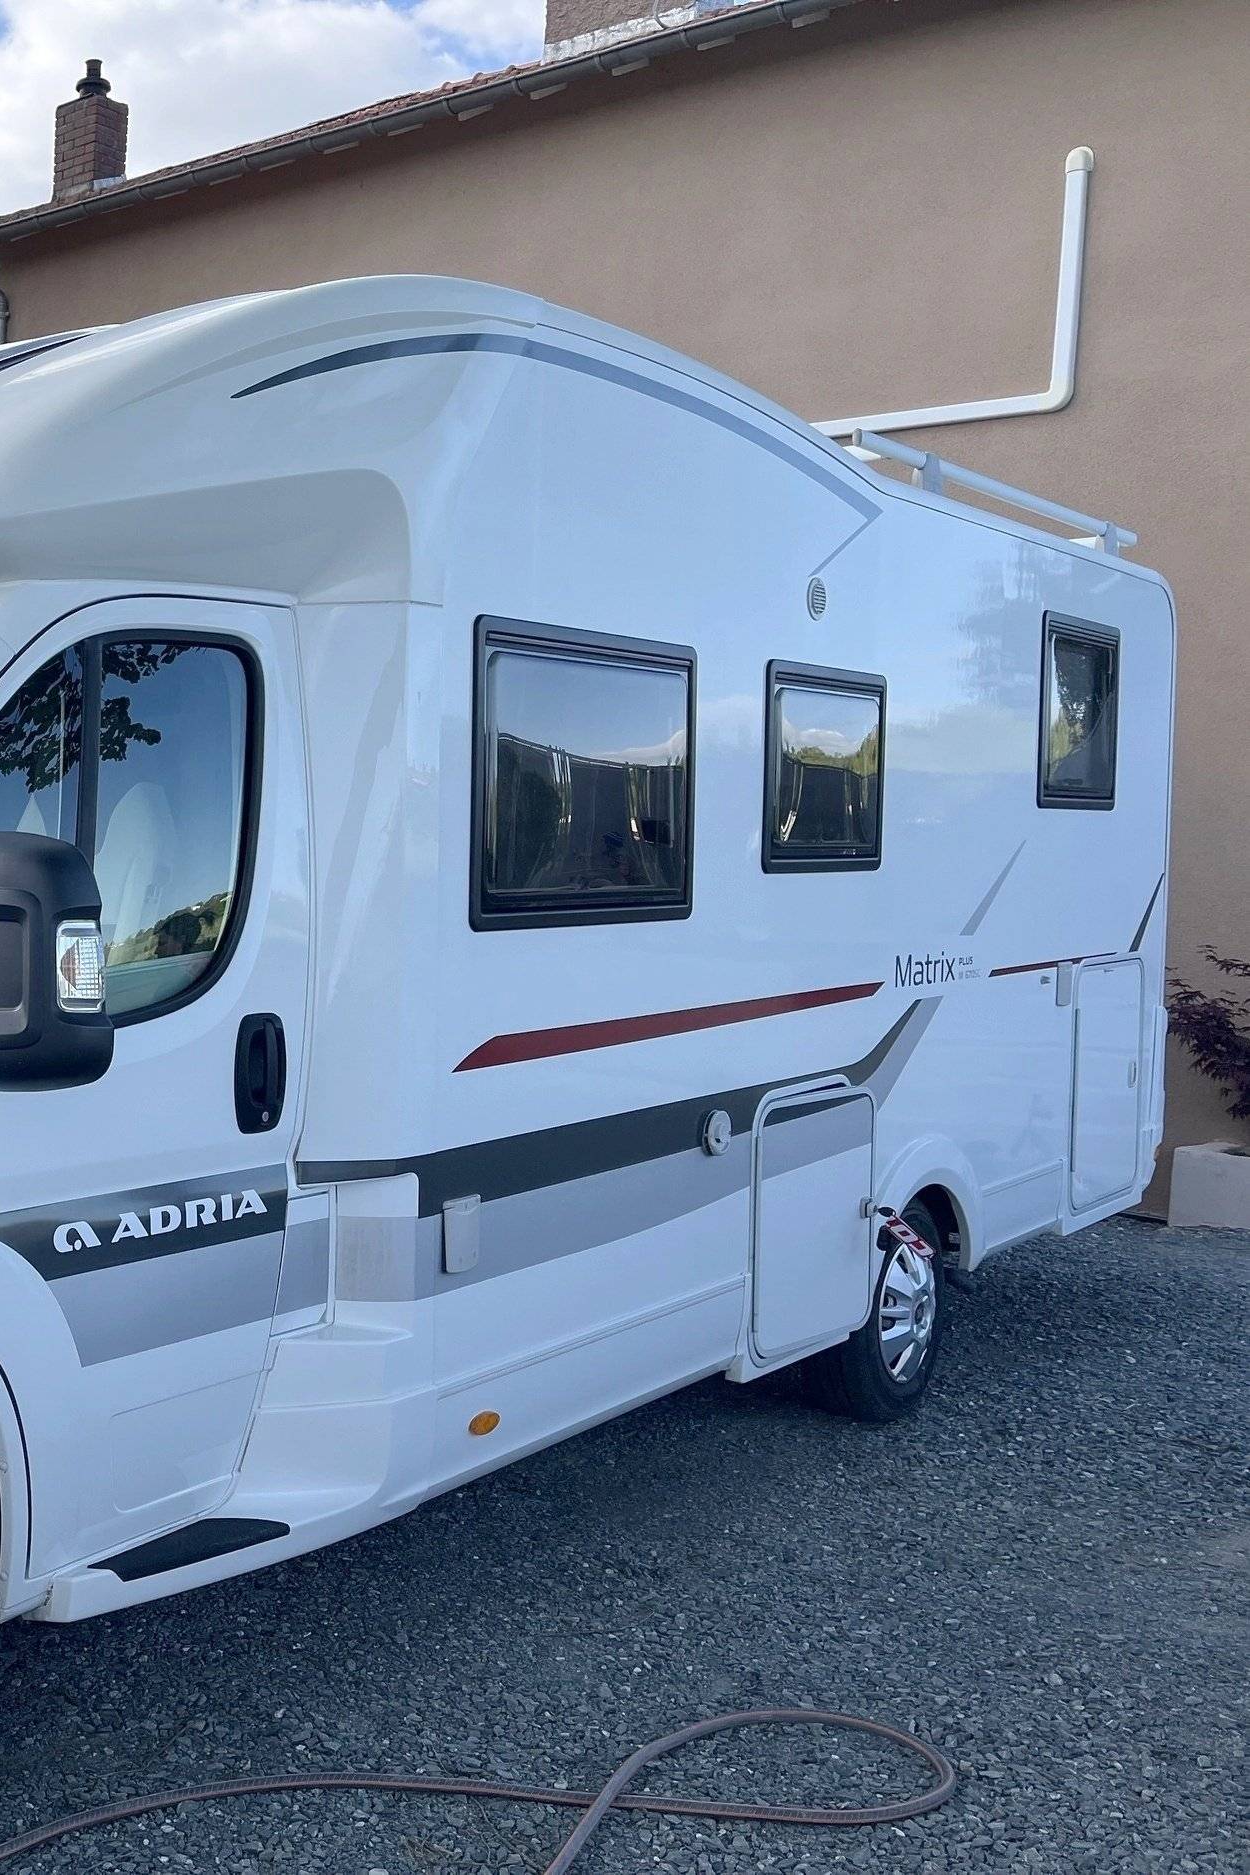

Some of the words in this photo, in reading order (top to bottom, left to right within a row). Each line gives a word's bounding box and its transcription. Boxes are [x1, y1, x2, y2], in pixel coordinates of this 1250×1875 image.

[895, 951, 955, 988] Matrix
[958, 956, 973, 966] PLUS
[111, 1189, 268, 1243] ADRIA
